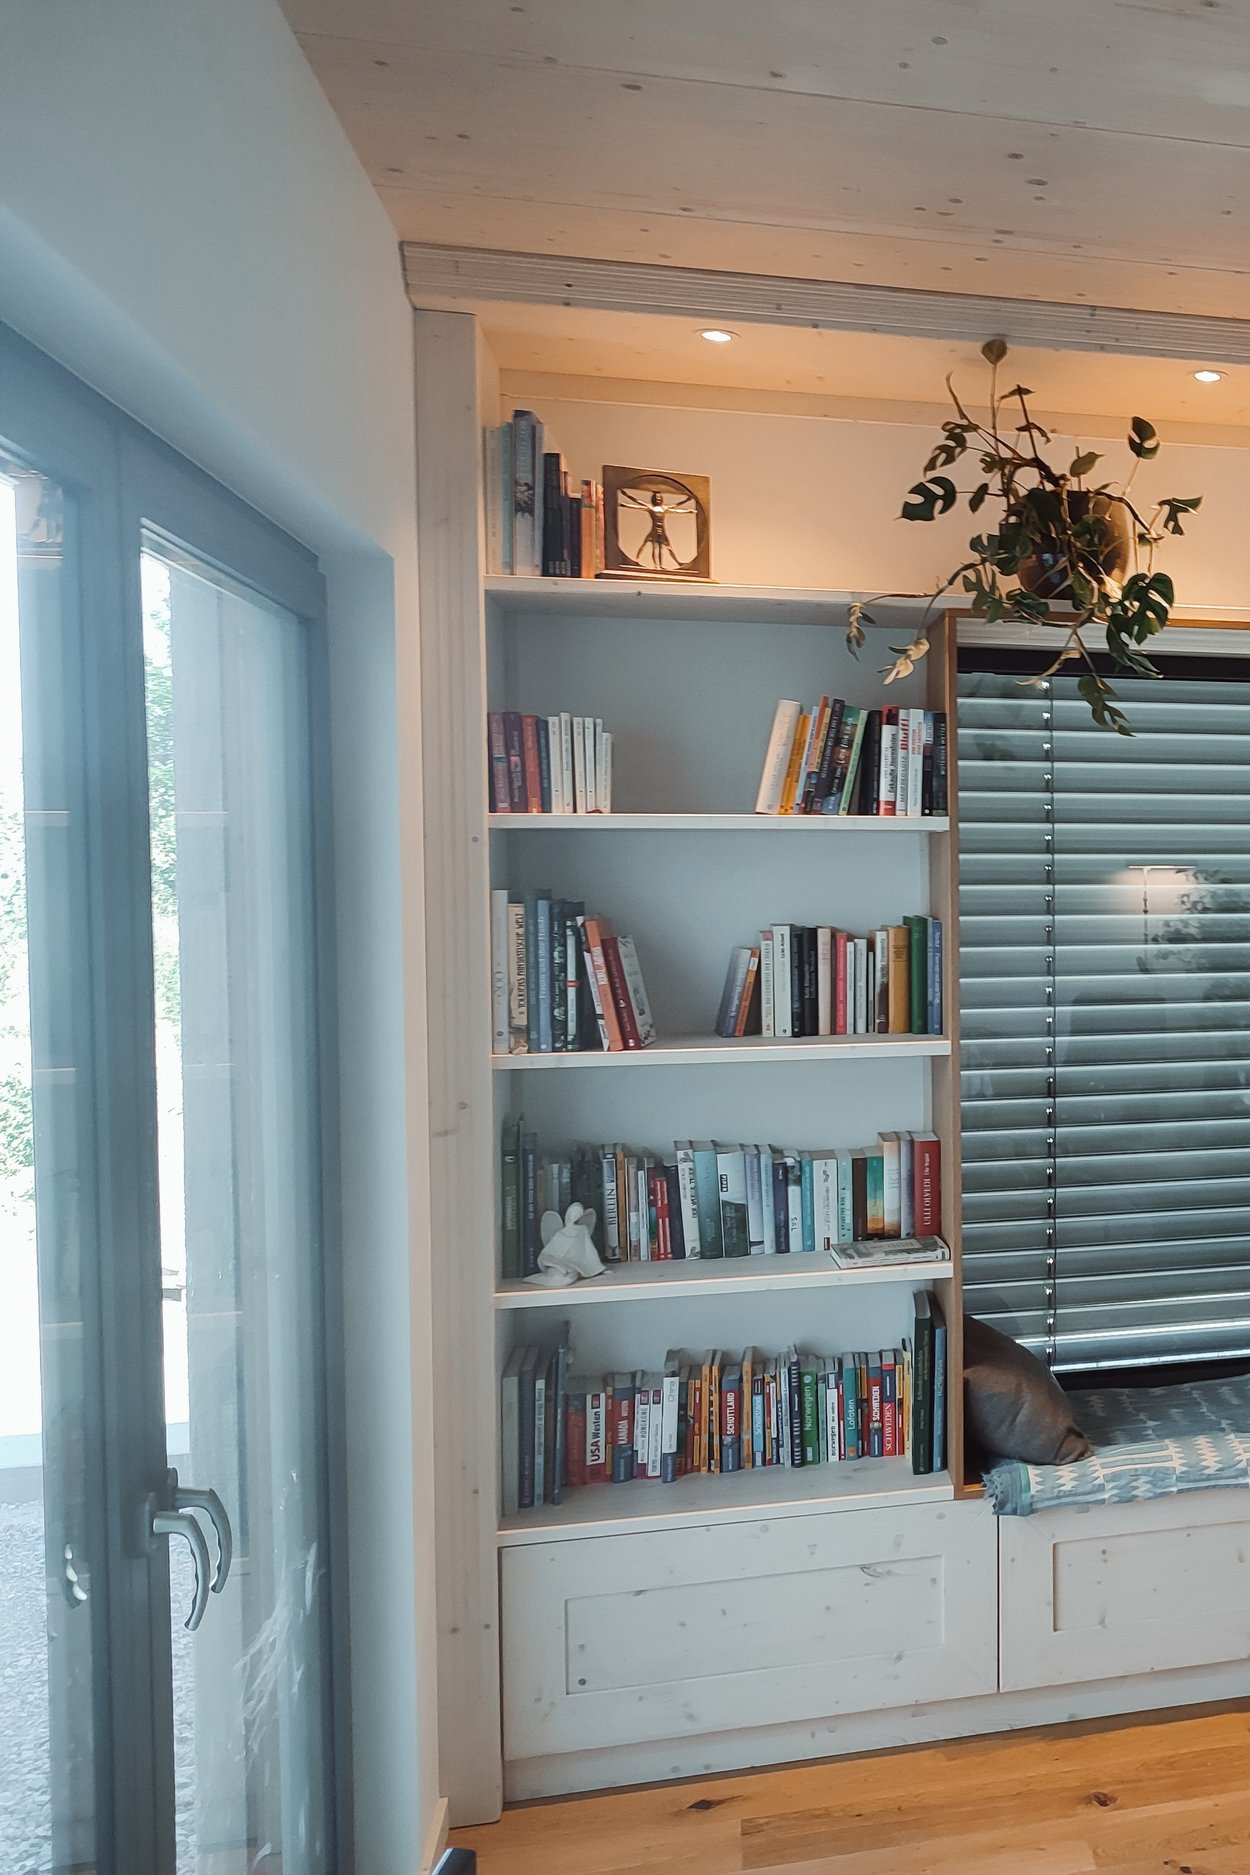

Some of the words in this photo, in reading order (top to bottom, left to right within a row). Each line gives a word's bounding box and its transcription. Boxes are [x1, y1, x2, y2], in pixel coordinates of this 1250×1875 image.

[607, 1188, 616, 1226] BERLIN
[923, 1206, 932, 1225] ULLI
[668, 1381, 676, 1403] China
[804, 1386, 813, 1431] Norwegen
[872, 1385, 881, 1421] SCHWEDEN
[591, 1411, 600, 1441] Westen
[727, 1392, 735, 1435] SCHOTTLAND
[755, 1396, 763, 1436] Schottland
[885, 1403, 894, 1451] SCHWEDEN
[618, 1420, 629, 1445] KANADA
[590, 1441, 600, 1462] USA
